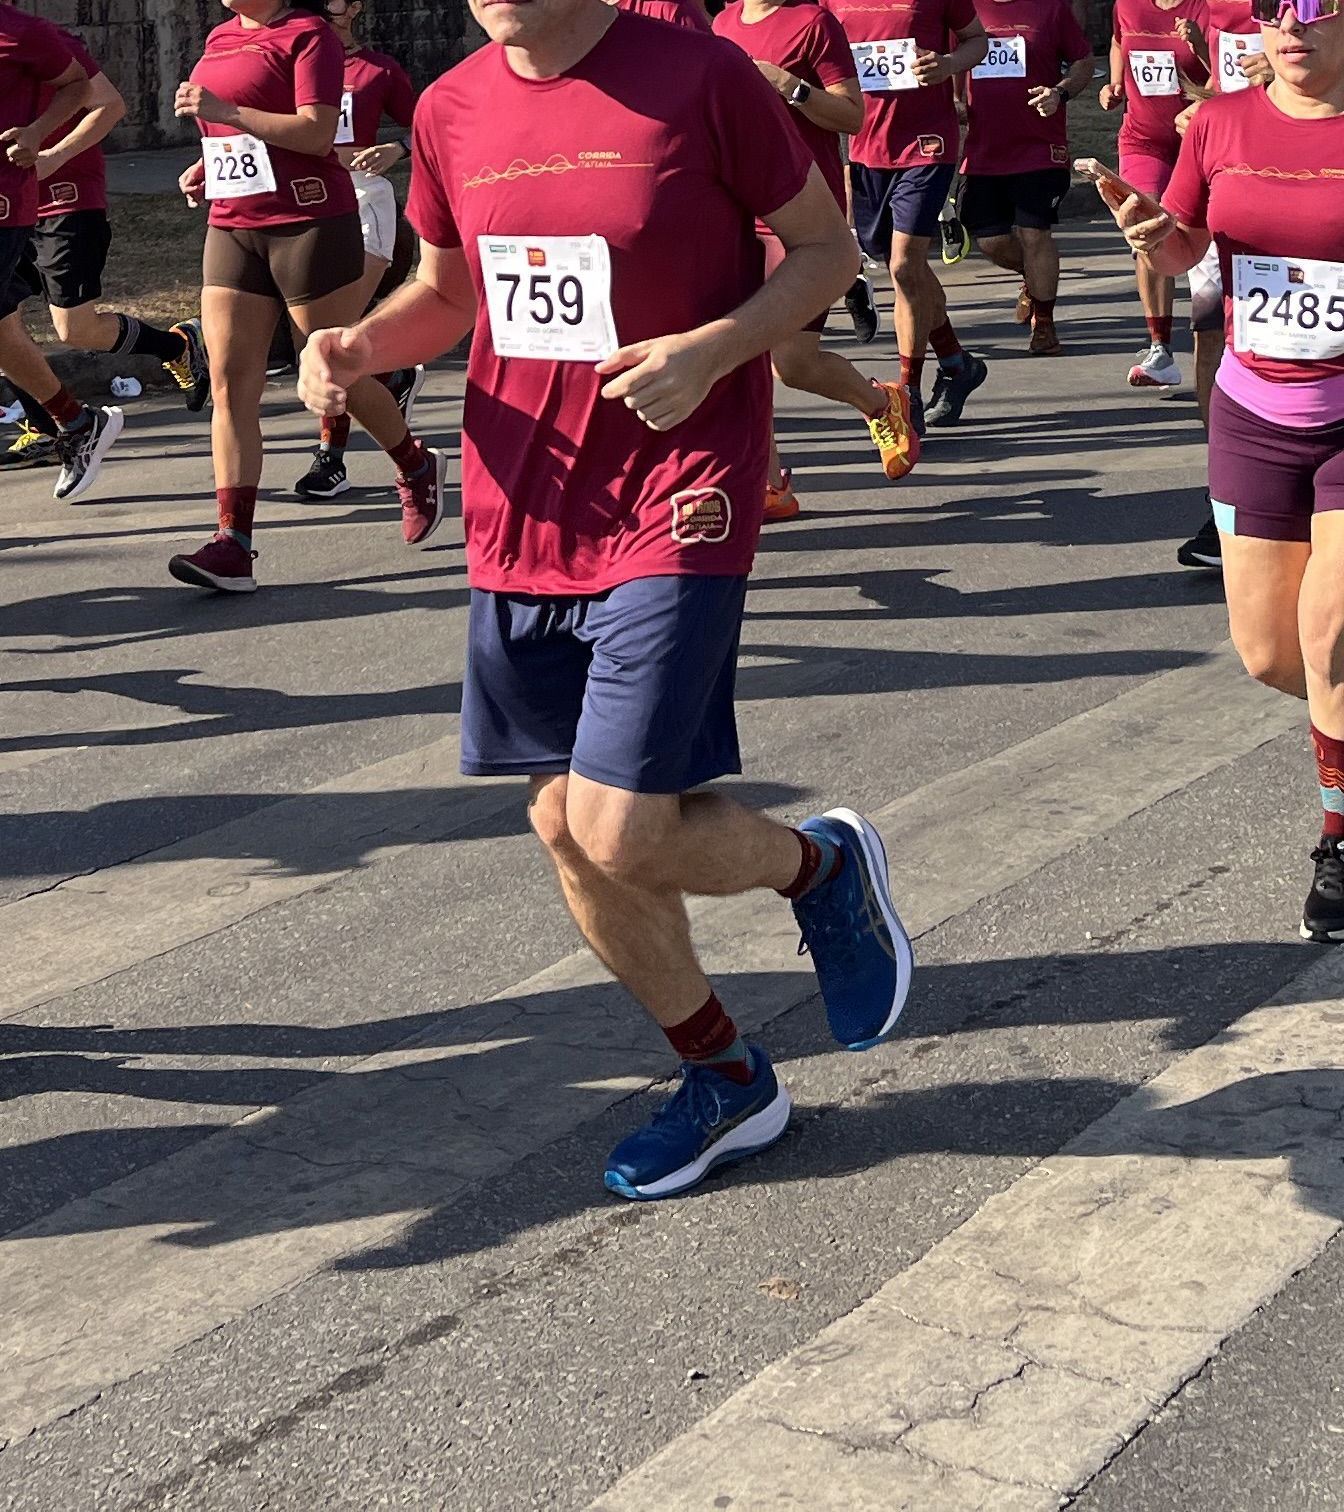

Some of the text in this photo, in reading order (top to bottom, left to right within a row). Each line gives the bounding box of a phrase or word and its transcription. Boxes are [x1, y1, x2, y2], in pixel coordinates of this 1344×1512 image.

[862, 54, 905, 78] 265
[1133, 66, 1175, 82] 1677
[214, 153, 258, 181] 228
[577, 152, 622, 160] CORRIDA
[496, 273, 584, 325] 759
